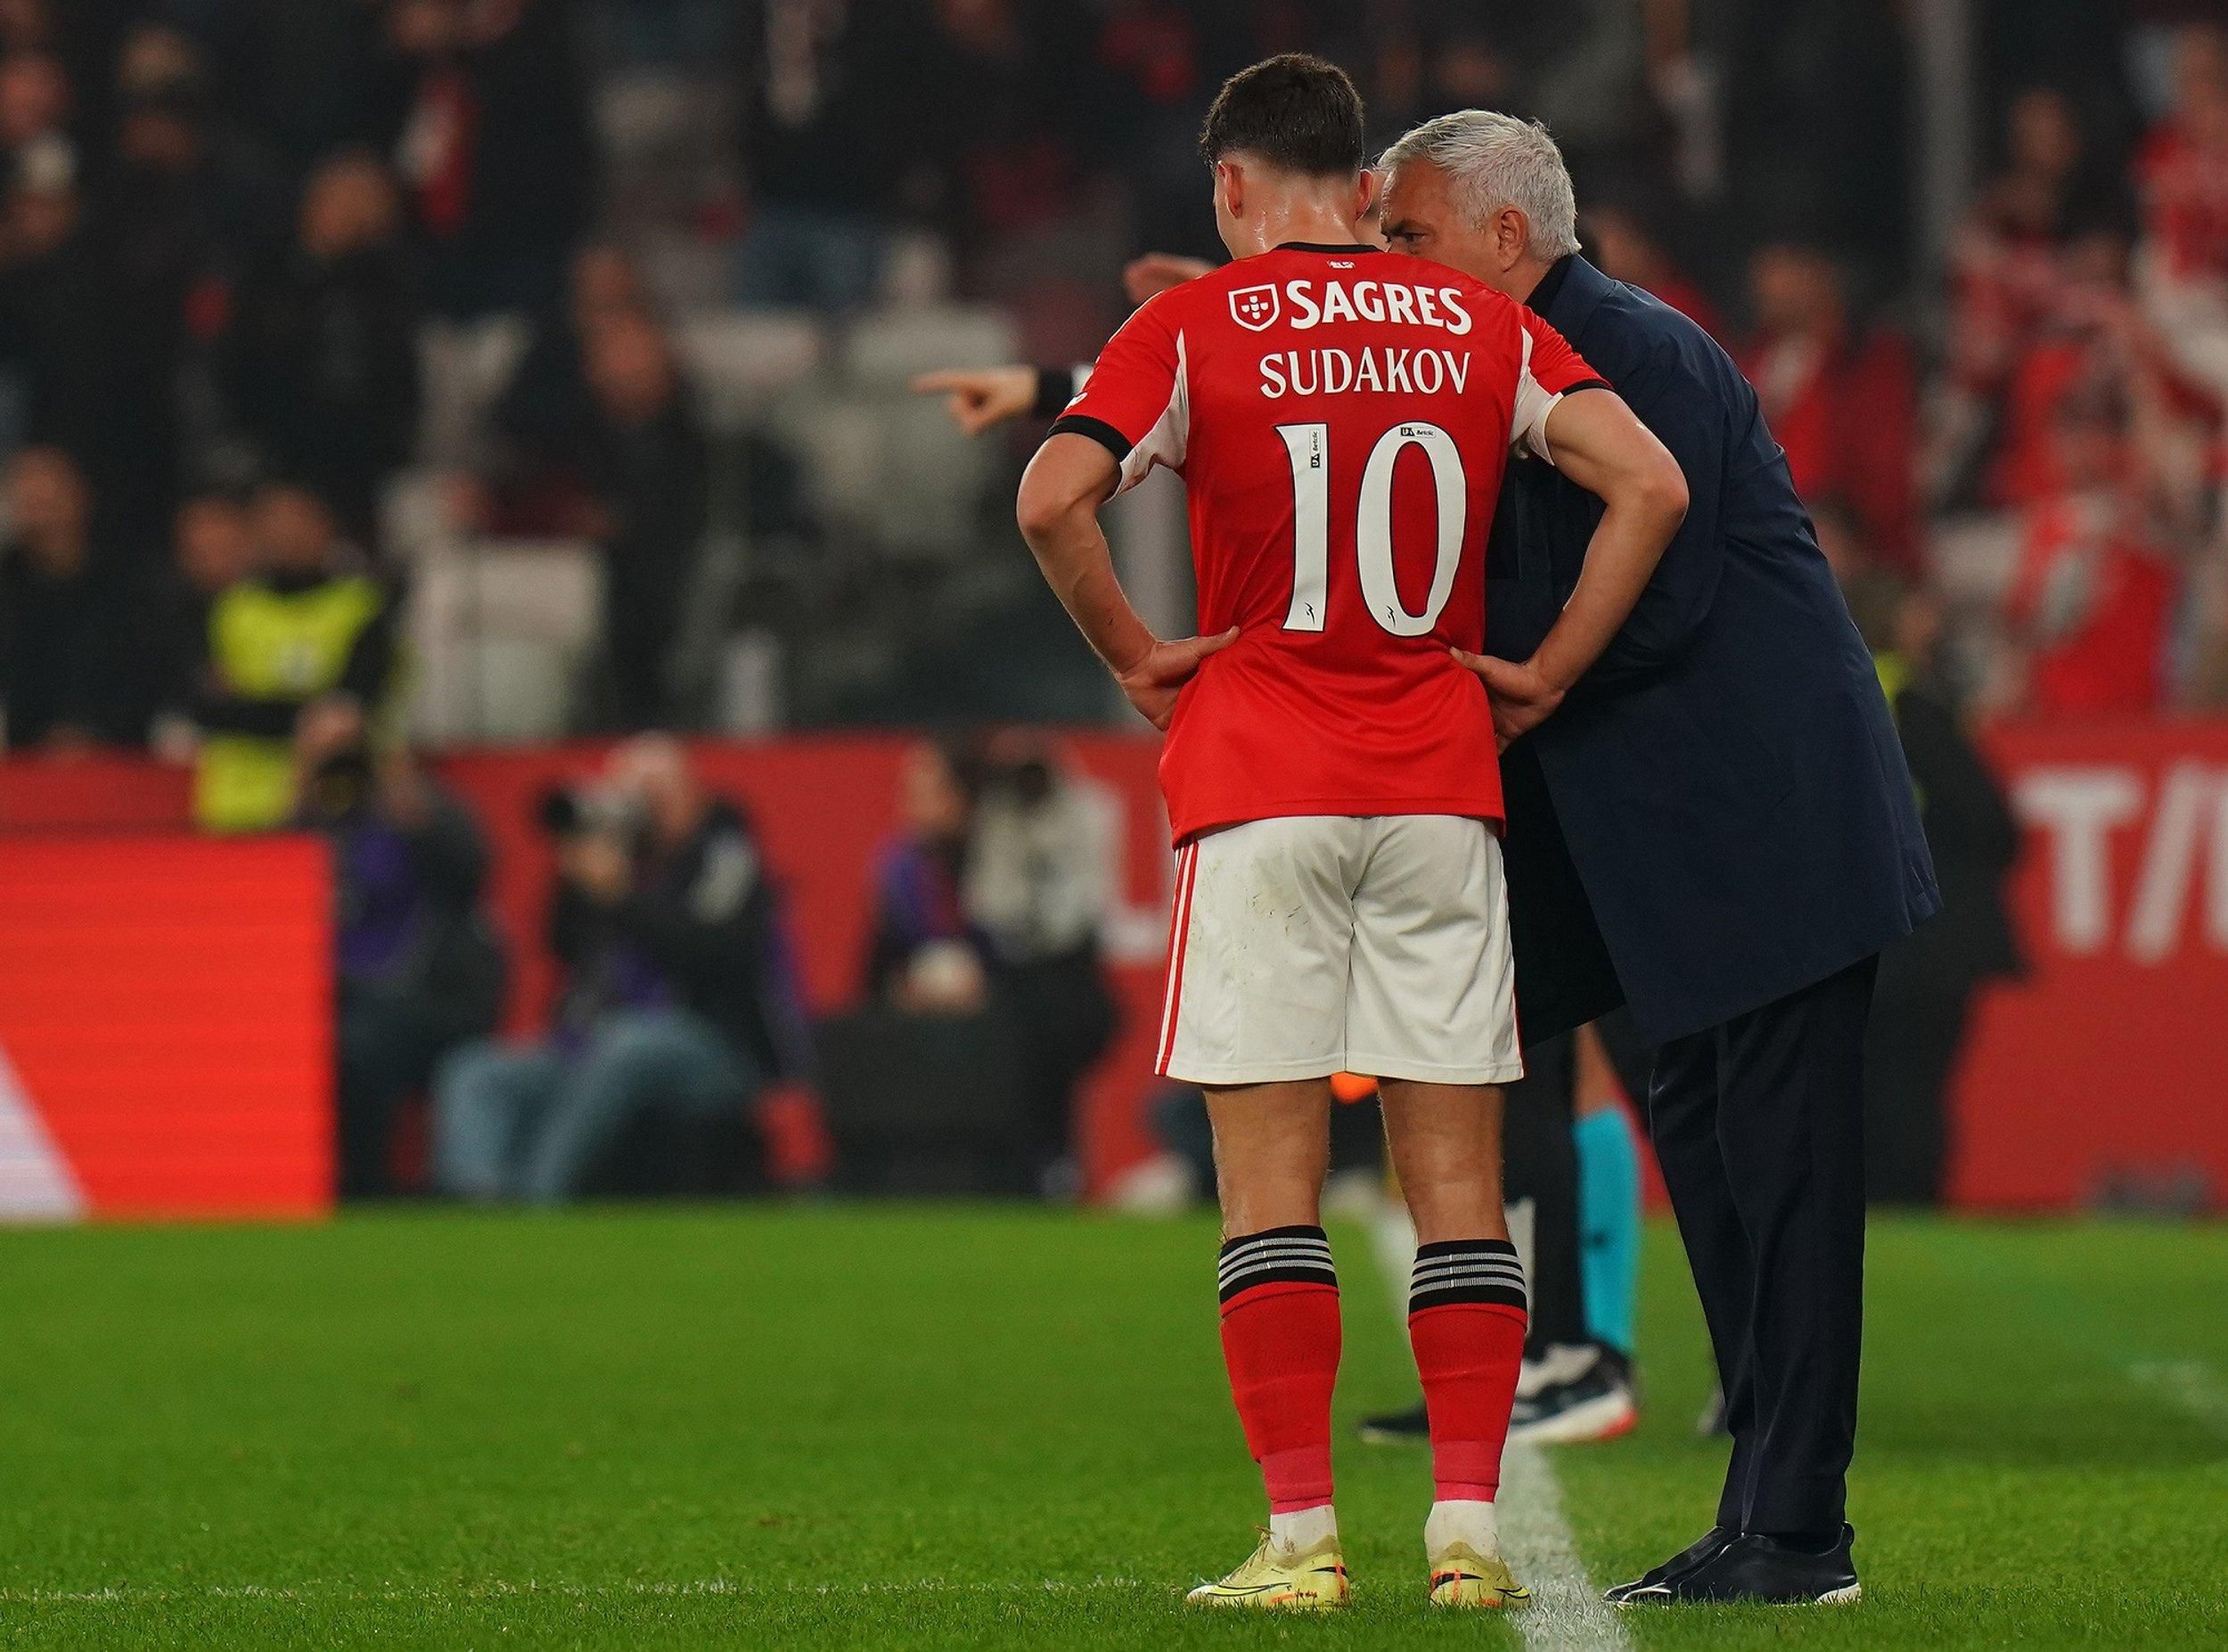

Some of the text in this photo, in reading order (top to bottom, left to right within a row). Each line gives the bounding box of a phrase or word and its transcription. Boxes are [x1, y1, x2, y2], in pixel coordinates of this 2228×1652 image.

[1285, 279, 1473, 336] SAGRES
[1258, 346, 1471, 399] SUDAKOV
[1274, 421, 1467, 636] 10
